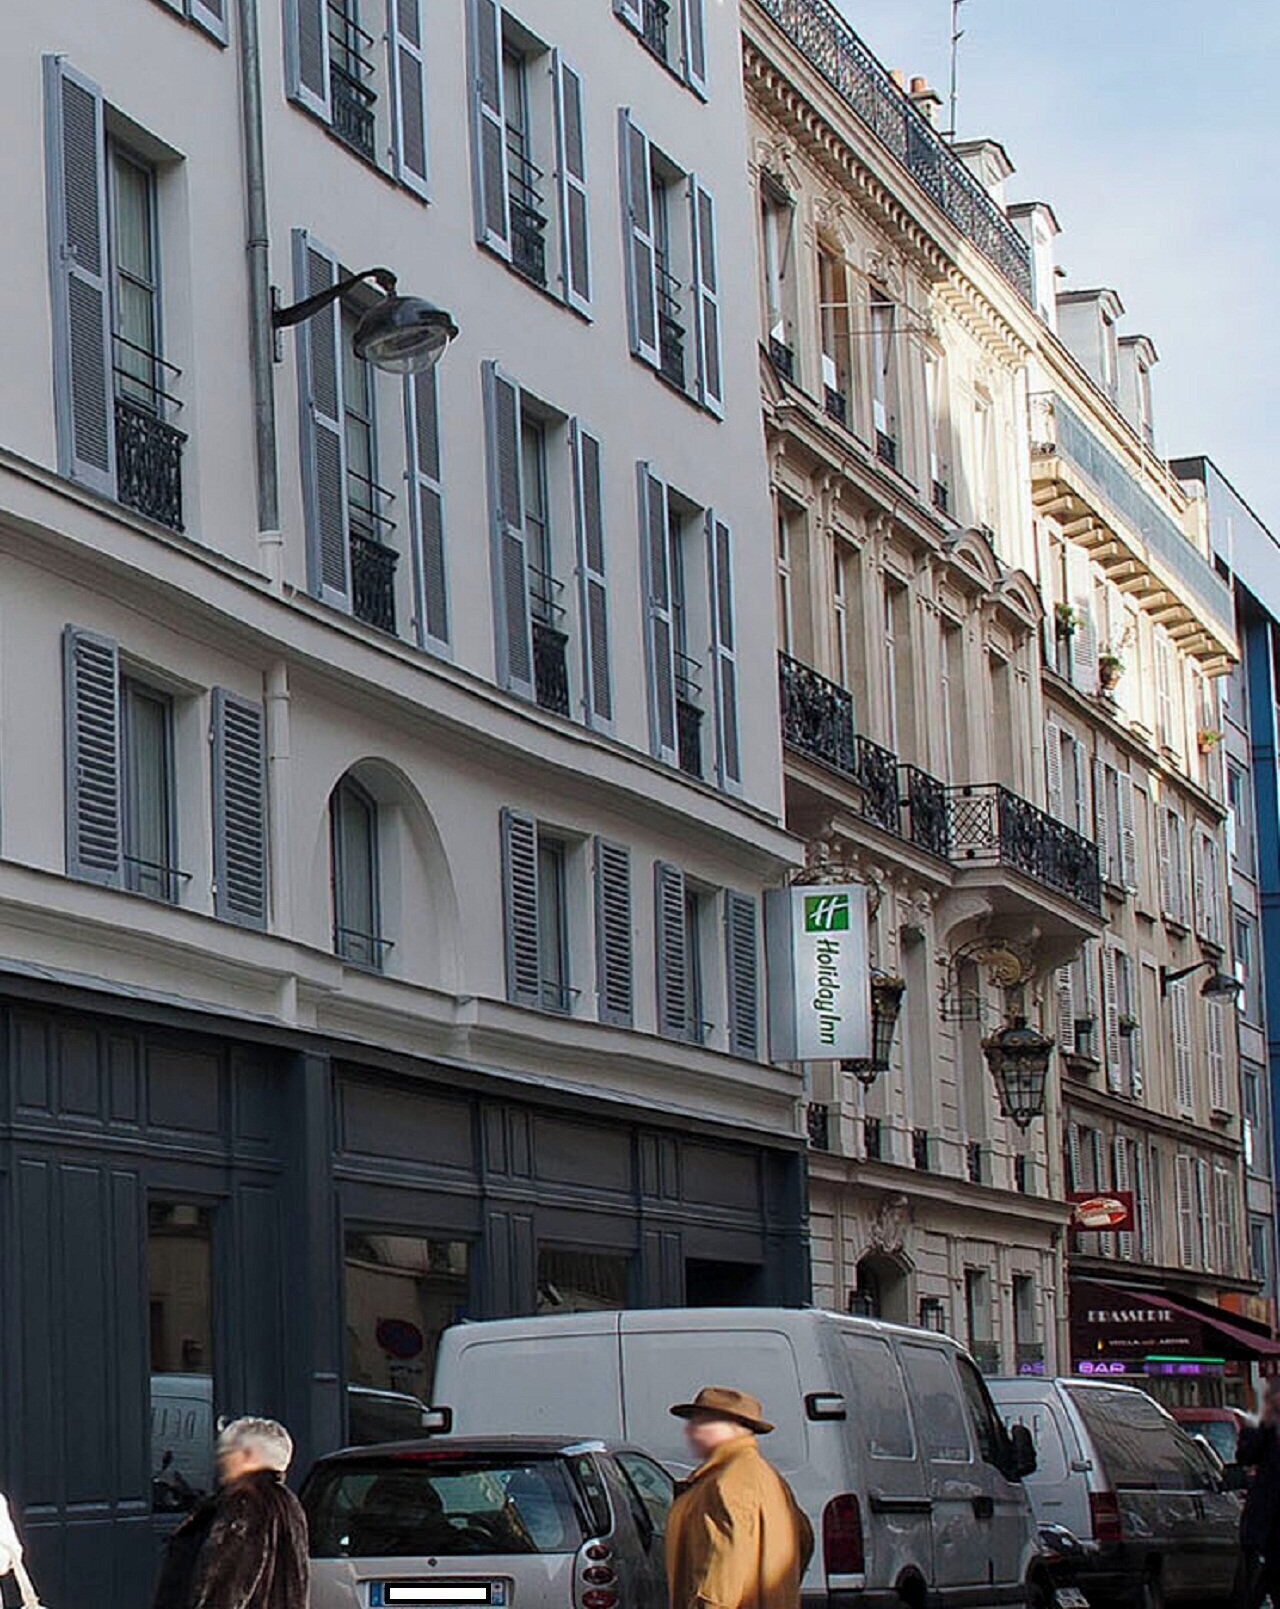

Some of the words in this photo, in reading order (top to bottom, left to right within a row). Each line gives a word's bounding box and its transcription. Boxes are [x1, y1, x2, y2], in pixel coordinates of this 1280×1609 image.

[813, 938, 841, 1012] Holiday
[819, 1014, 842, 1045] Inn
[1078, 1362, 1126, 1374] BAR
